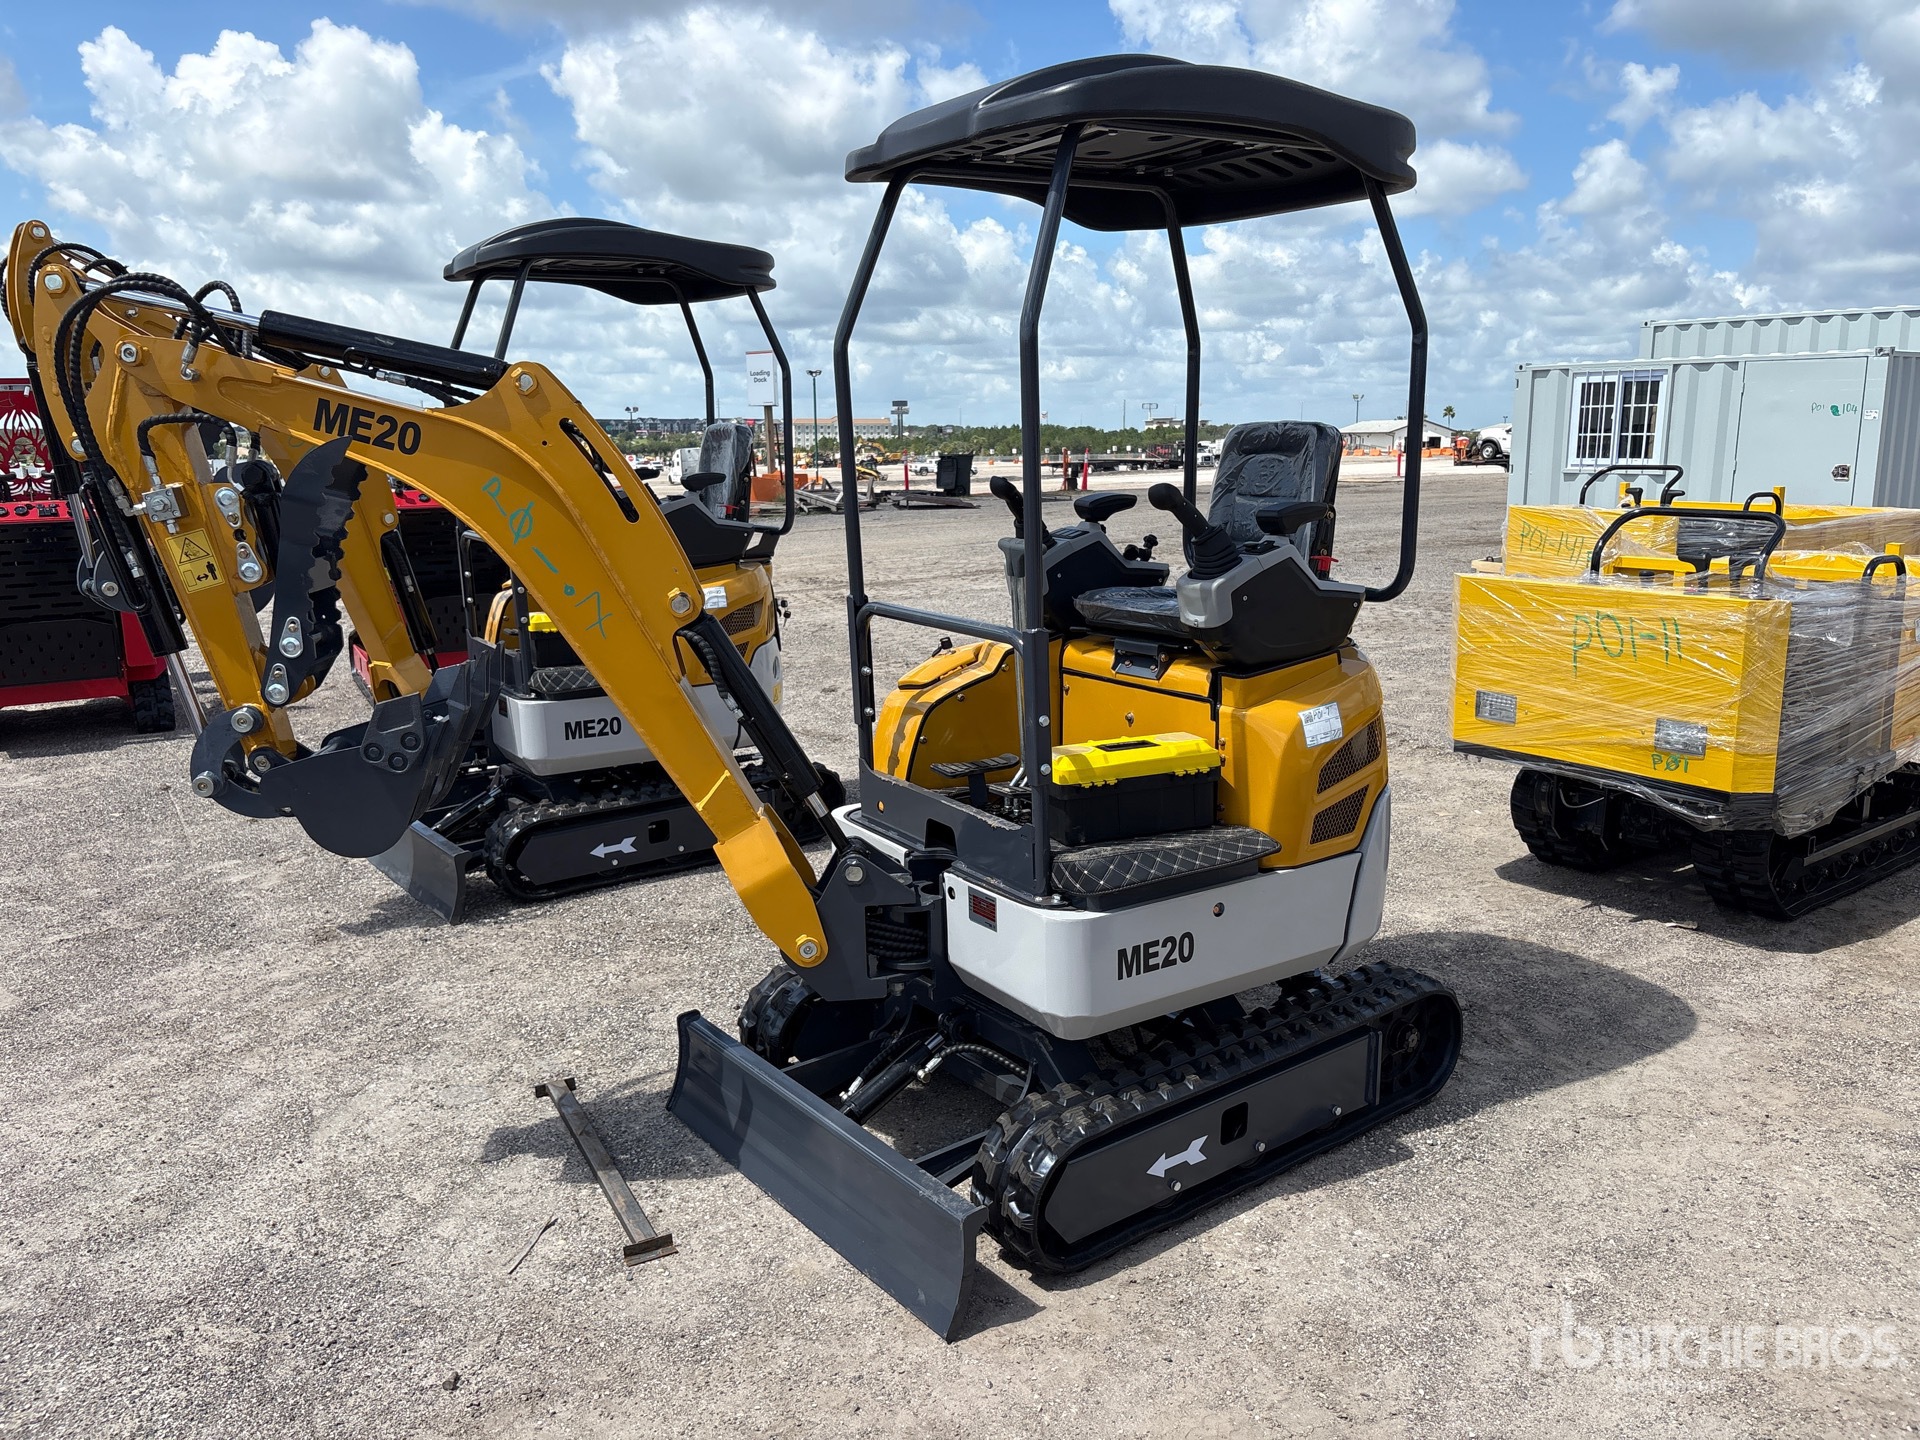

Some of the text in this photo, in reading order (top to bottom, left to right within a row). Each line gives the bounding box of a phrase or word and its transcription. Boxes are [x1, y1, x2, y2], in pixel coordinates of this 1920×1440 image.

[313, 398, 422, 456] ME20
[1842, 403, 1858, 415] 104
[564, 716, 622, 741] ME20
[1117, 931, 1195, 981] ME20
